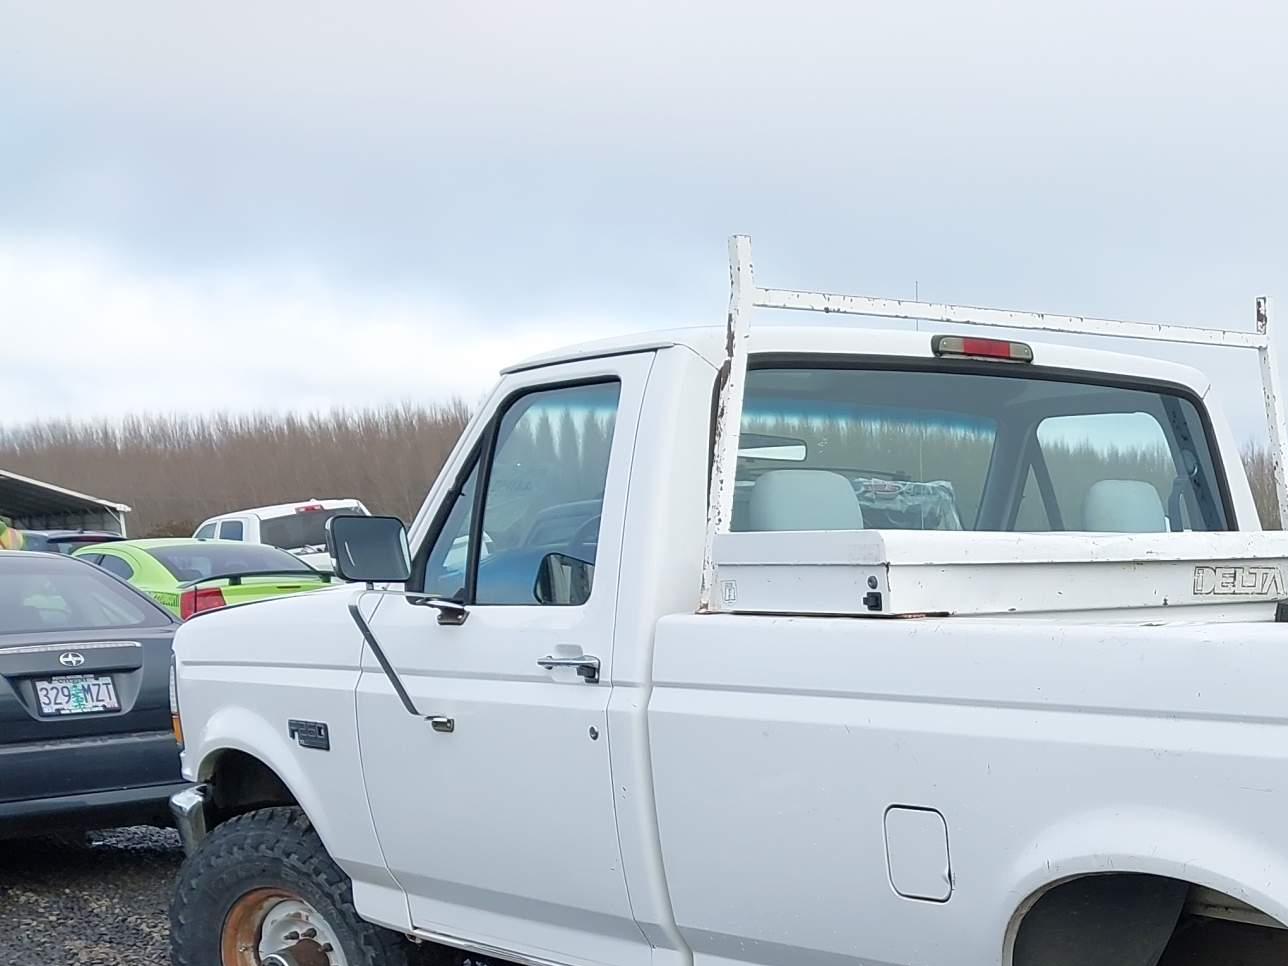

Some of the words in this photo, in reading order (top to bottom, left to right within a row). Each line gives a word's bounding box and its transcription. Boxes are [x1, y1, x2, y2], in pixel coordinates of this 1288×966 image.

[1193, 566, 1287, 595] DELTA
[40, 686, 71, 705] 329
[81, 682, 112, 703] MZT
